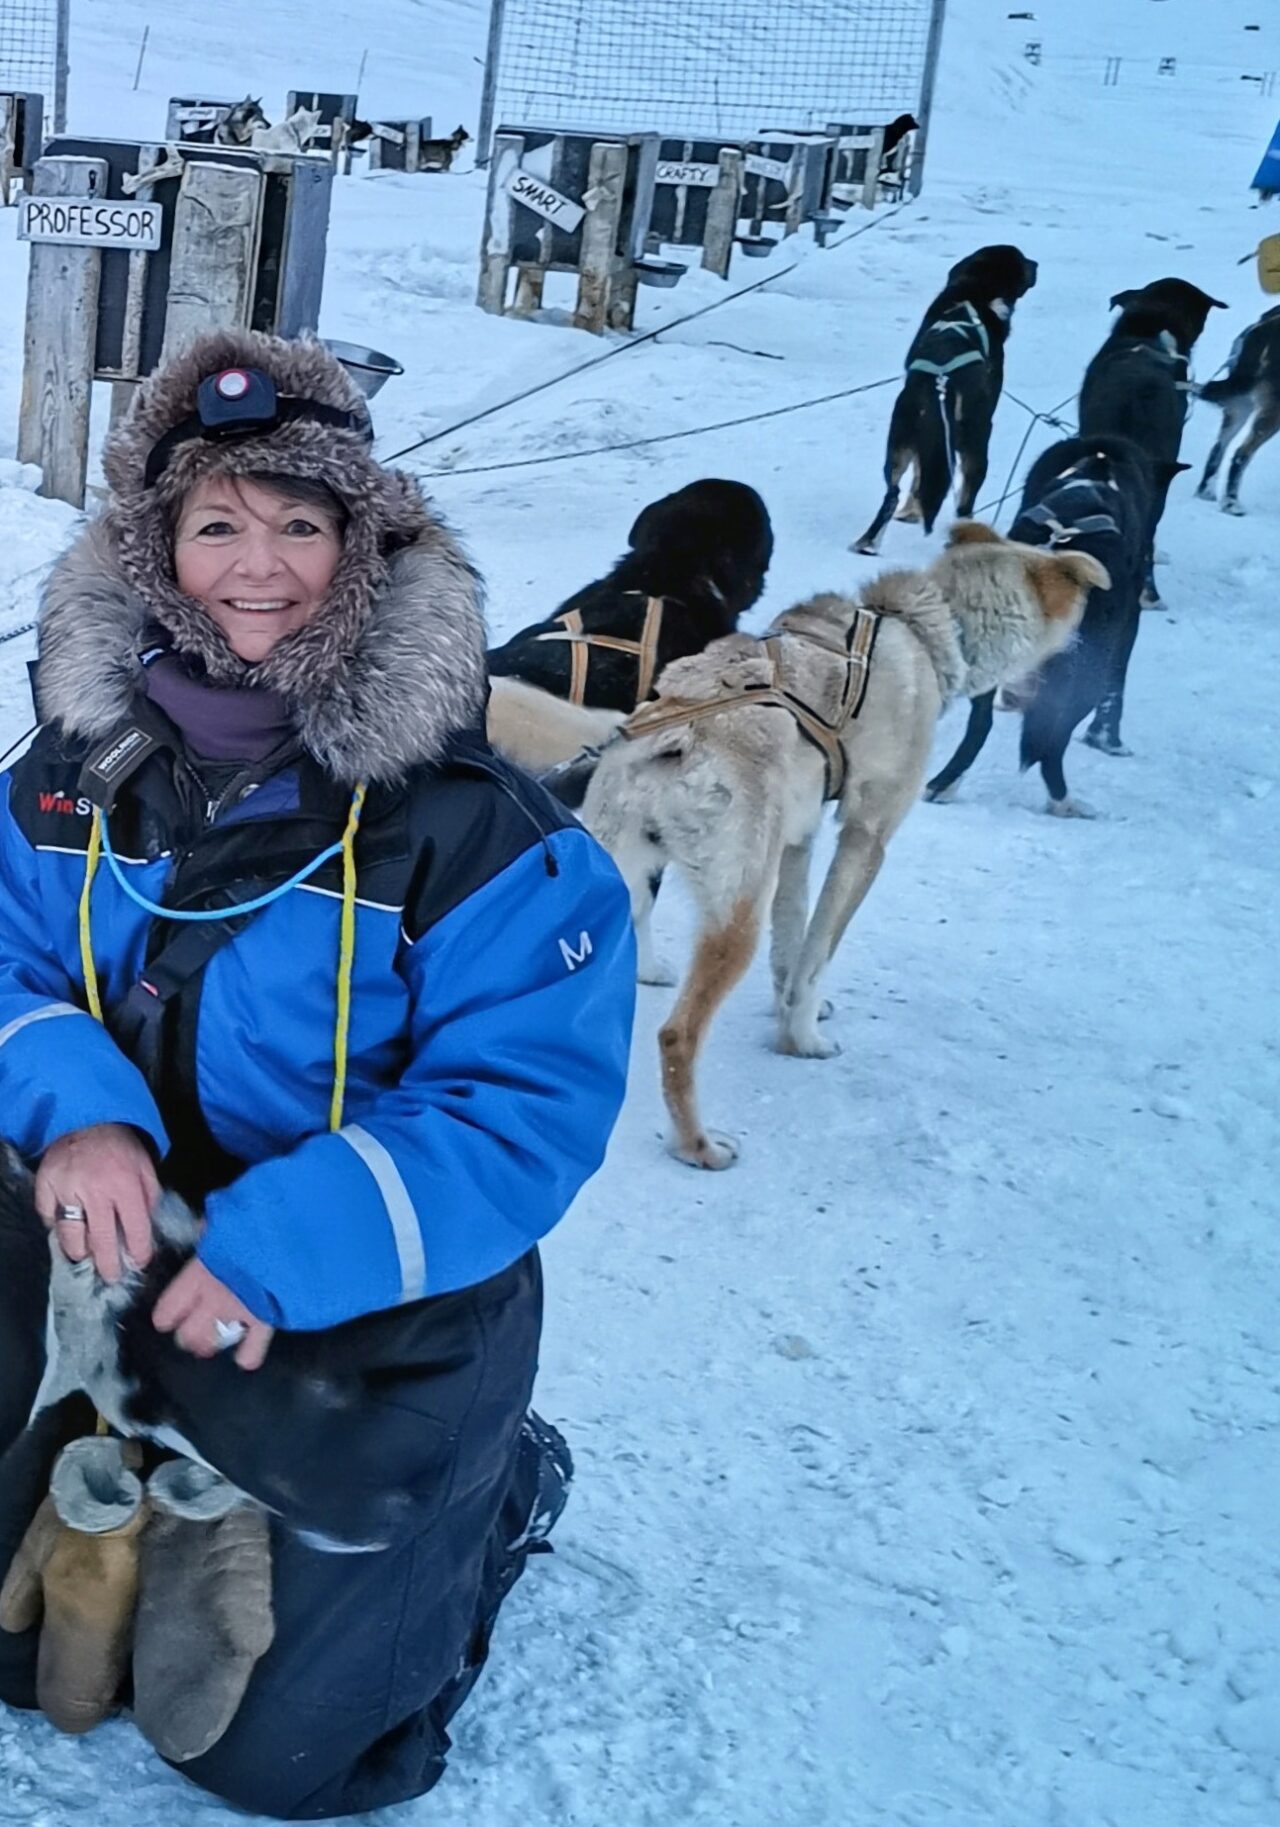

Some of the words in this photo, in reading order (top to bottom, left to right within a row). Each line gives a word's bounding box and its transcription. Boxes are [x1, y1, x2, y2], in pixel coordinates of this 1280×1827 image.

[657, 166, 709, 181] CRAFTY
[512, 176, 568, 215] SMART
[27, 203, 153, 240] PROFESSOR
[39, 791, 92, 815] WinS
